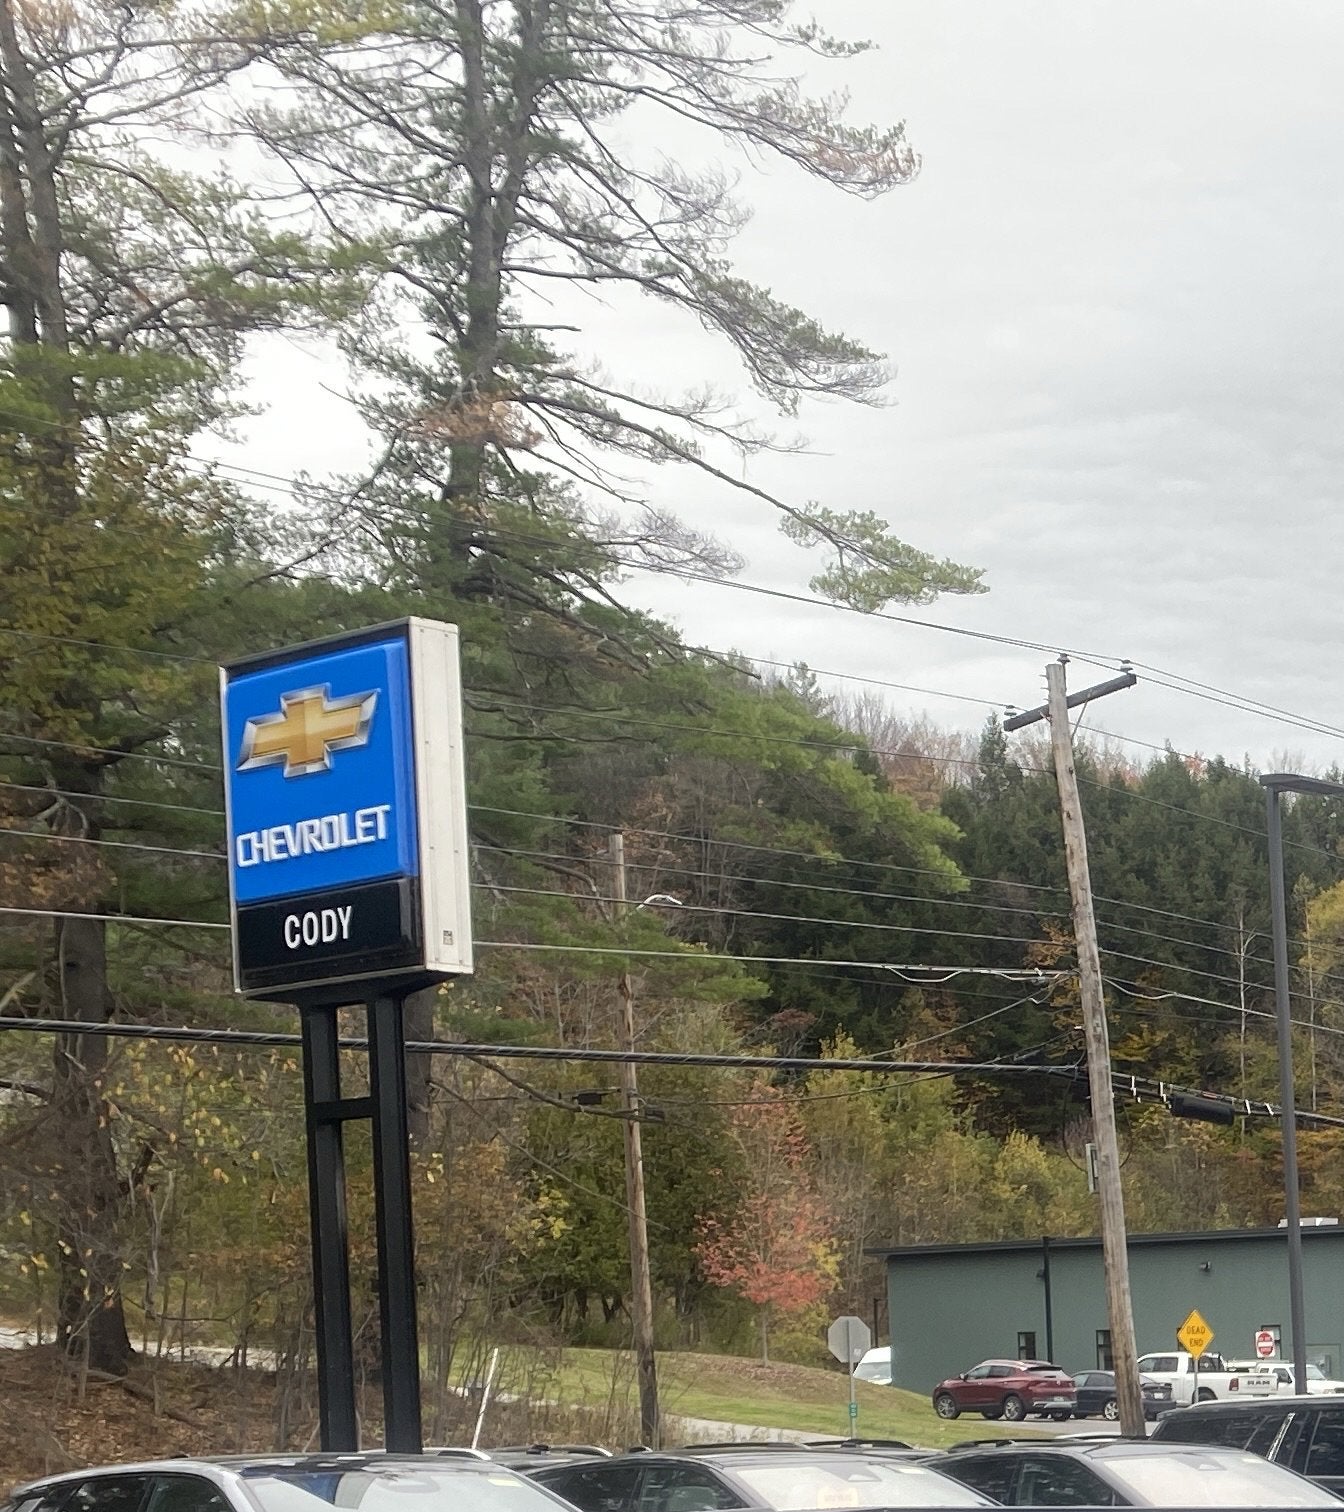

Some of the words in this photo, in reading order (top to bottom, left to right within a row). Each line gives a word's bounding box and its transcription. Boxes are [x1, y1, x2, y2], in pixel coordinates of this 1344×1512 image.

[236, 804, 390, 867] CHEVROLET
[284, 906, 352, 949] CODY
[1186, 1325, 1206, 1334] DEAD
[1189, 1338, 1203, 1347] END
